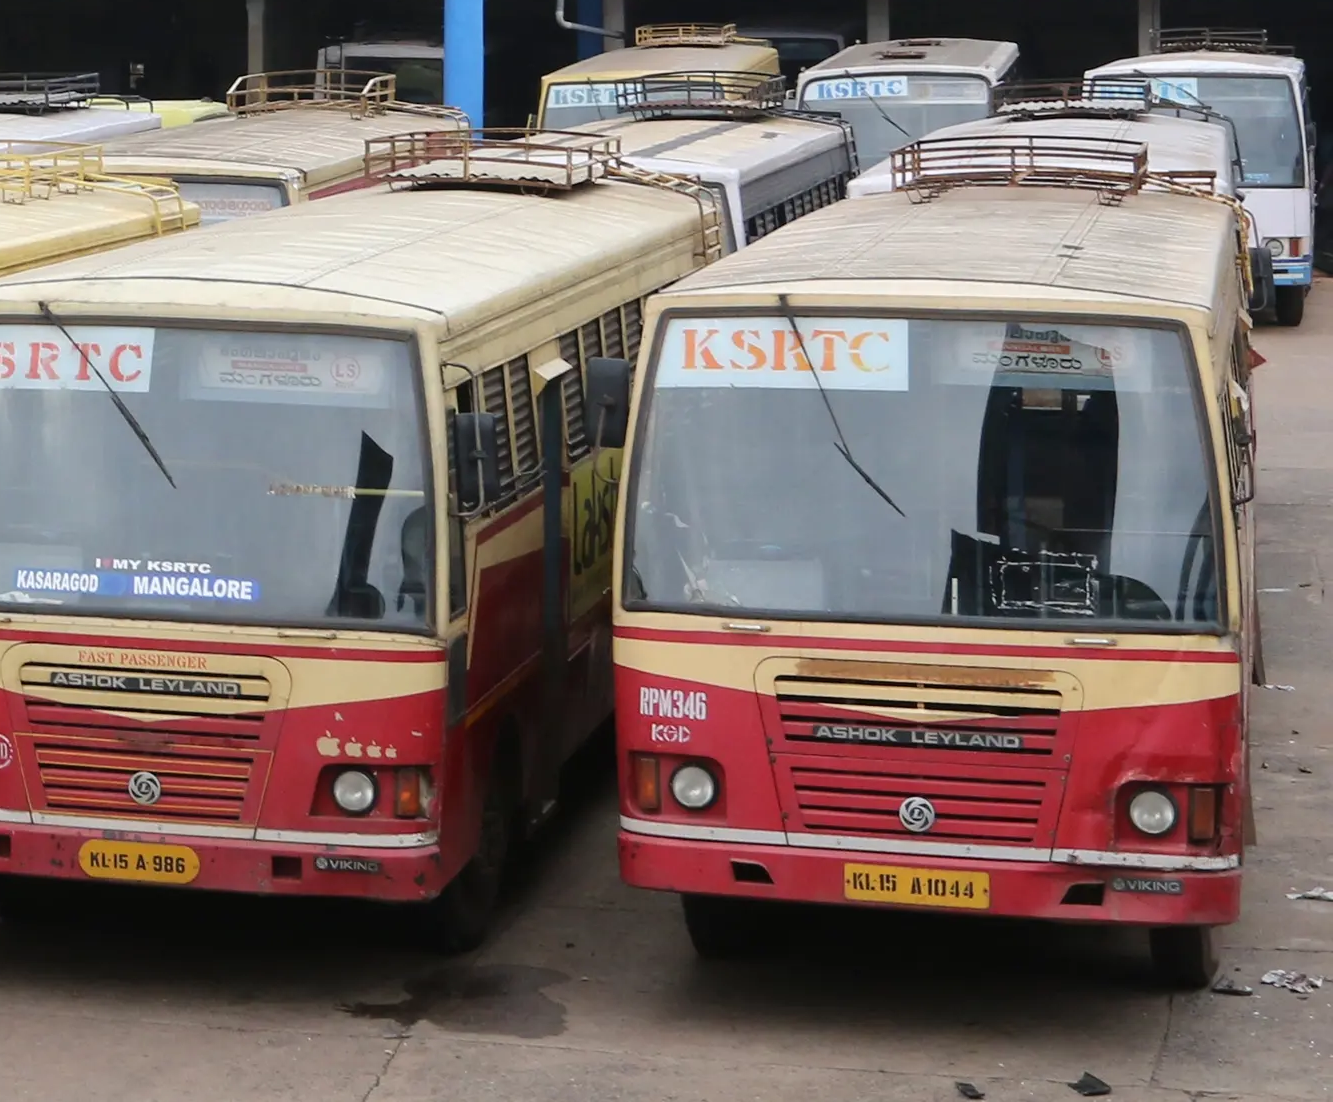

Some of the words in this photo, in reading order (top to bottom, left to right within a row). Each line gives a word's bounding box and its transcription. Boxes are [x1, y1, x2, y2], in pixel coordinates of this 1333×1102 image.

[817, 80, 902, 99] KSRTC
[681, 329, 890, 372] KSRTC
[112, 559, 142, 571] MY
[147, 560, 212, 574] KSRTC
[16, 569, 99, 593] KASARAGOD
[133, 575, 254, 600] MANGALORE
[78, 650, 115, 664] FAST
[120, 653, 208, 670] PASSENGER
[52, 672, 127, 689] ASHOK
[138, 678, 239, 696] LEYLAND
[639, 685, 707, 721] RPM346
[650, 723, 691, 744] KGD
[816, 725, 898, 742] ASHOK
[910, 731, 1021, 749] LEYLAND
[328, 858, 379, 872] VIKING
[1125, 880, 1181, 893] VIKING
